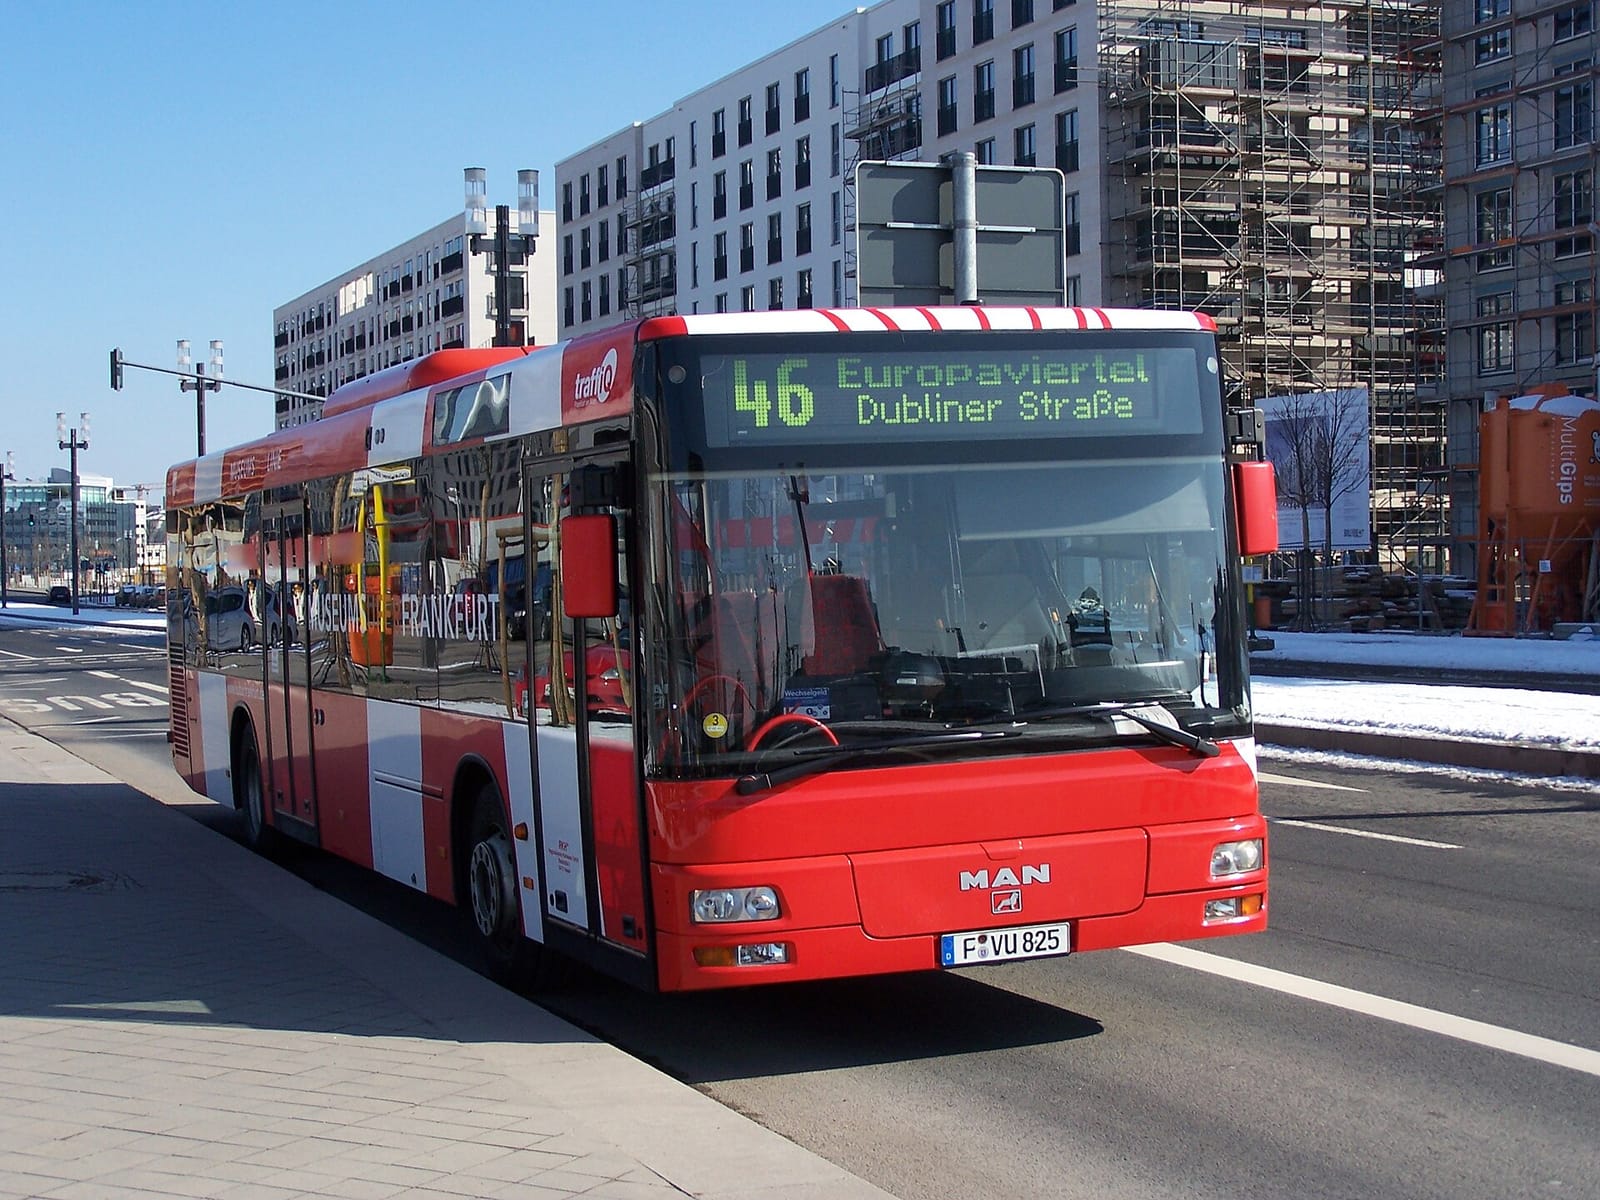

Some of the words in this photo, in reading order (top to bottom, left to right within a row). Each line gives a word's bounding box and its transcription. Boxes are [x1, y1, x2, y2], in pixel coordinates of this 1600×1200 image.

[574, 348, 618, 403] traffiQ
[838, 354, 1149, 388] Europaviertel
[733, 357, 815, 428] 46
[857, 392, 1003, 425] Dubliner
[1018, 389, 1134, 421] Straße
[1556, 416, 1578, 504] MultiGips
[402, 592, 500, 642] FRANKFURT
[784, 687, 828, 698] Wechselgeld
[712, 715, 719, 726] 3
[960, 863, 1051, 891] MAN
[963, 937, 976, 960] F
[990, 933, 1018, 956] VU
[1022, 928, 1060, 953] 825
